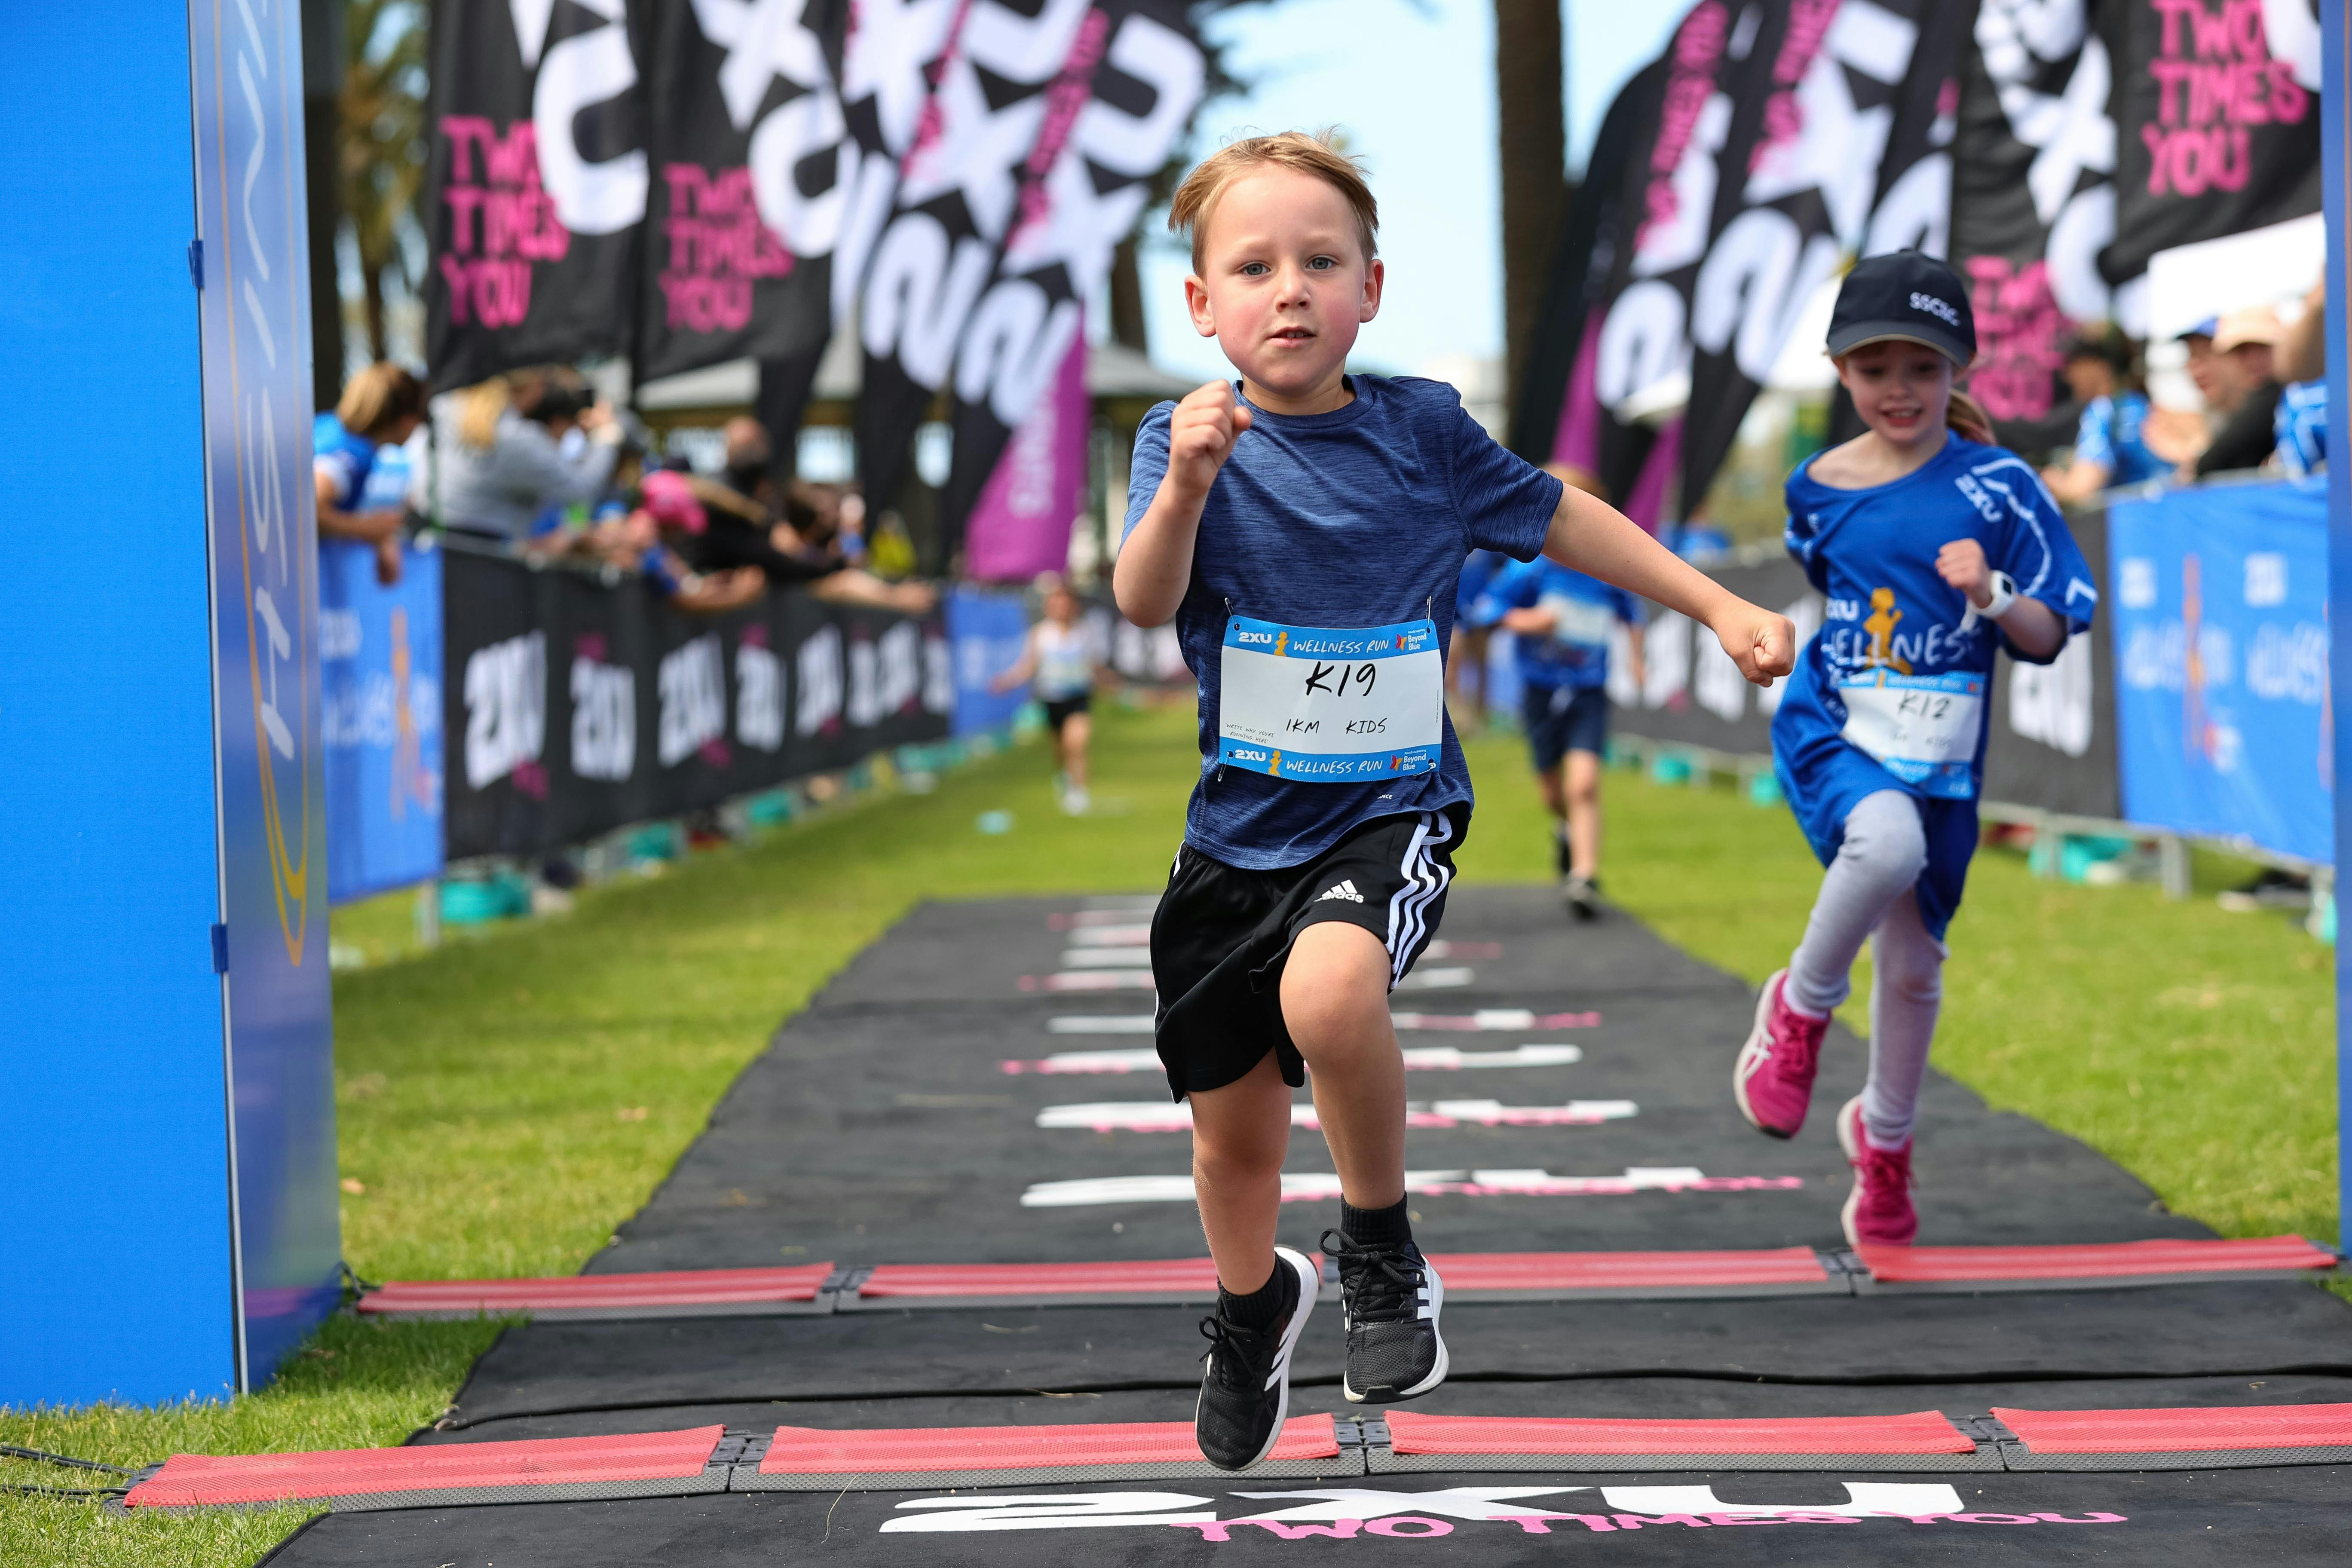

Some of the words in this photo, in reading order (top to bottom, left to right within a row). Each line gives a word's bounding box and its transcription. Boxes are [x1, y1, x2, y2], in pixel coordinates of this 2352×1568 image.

[2150, 60, 2309, 125] TIMES
[2141, 126, 2252, 198] YOU
[238, 0, 294, 762] INISH
[1238, 632, 1272, 644] 2XU
[1294, 639, 1363, 654] WELLNESS
[1366, 639, 1389, 653] RUN
[1408, 632, 1427, 643] Beyond
[1408, 643, 1421, 651] Blue
[1305, 661, 1376, 697] K19
[1230, 731, 1253, 740] RUNNING
[1286, 718, 1320, 734] 1KM
[1346, 717, 1387, 735] KIDS
[1235, 749, 1266, 762] 2XU
[1286, 760, 1354, 774] WELLNESS
[1357, 760, 1383, 773] RUN
[1403, 753, 1427, 764] Beyond
[1403, 763, 1416, 771] Blue
[879, 1481, 1966, 1533] 2XU
[1168, 1516, 1455, 1542] TWO
[1485, 1510, 1863, 1534] TIMES
[1875, 1510, 2129, 1524] YOU
